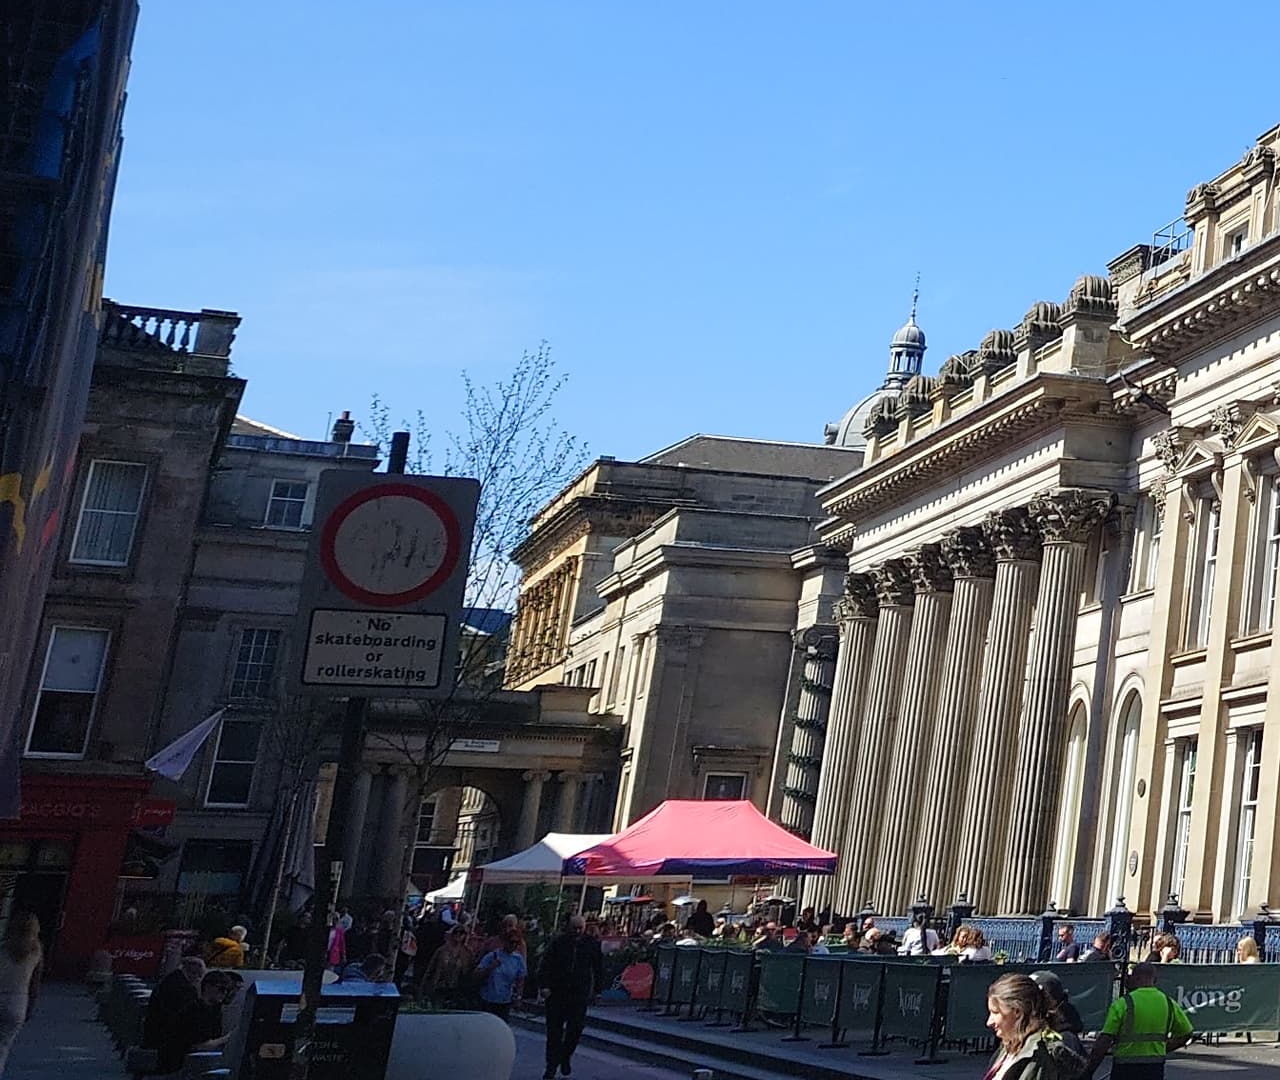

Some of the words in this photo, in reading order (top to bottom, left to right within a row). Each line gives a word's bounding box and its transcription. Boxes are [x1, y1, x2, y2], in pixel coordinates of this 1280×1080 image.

[367, 618, 392, 631] No
[315, 632, 436, 650] skateboarding
[366, 651, 384, 662] or
[317, 665, 426, 681] rollerskating
[1177, 986, 1245, 1013] kong
